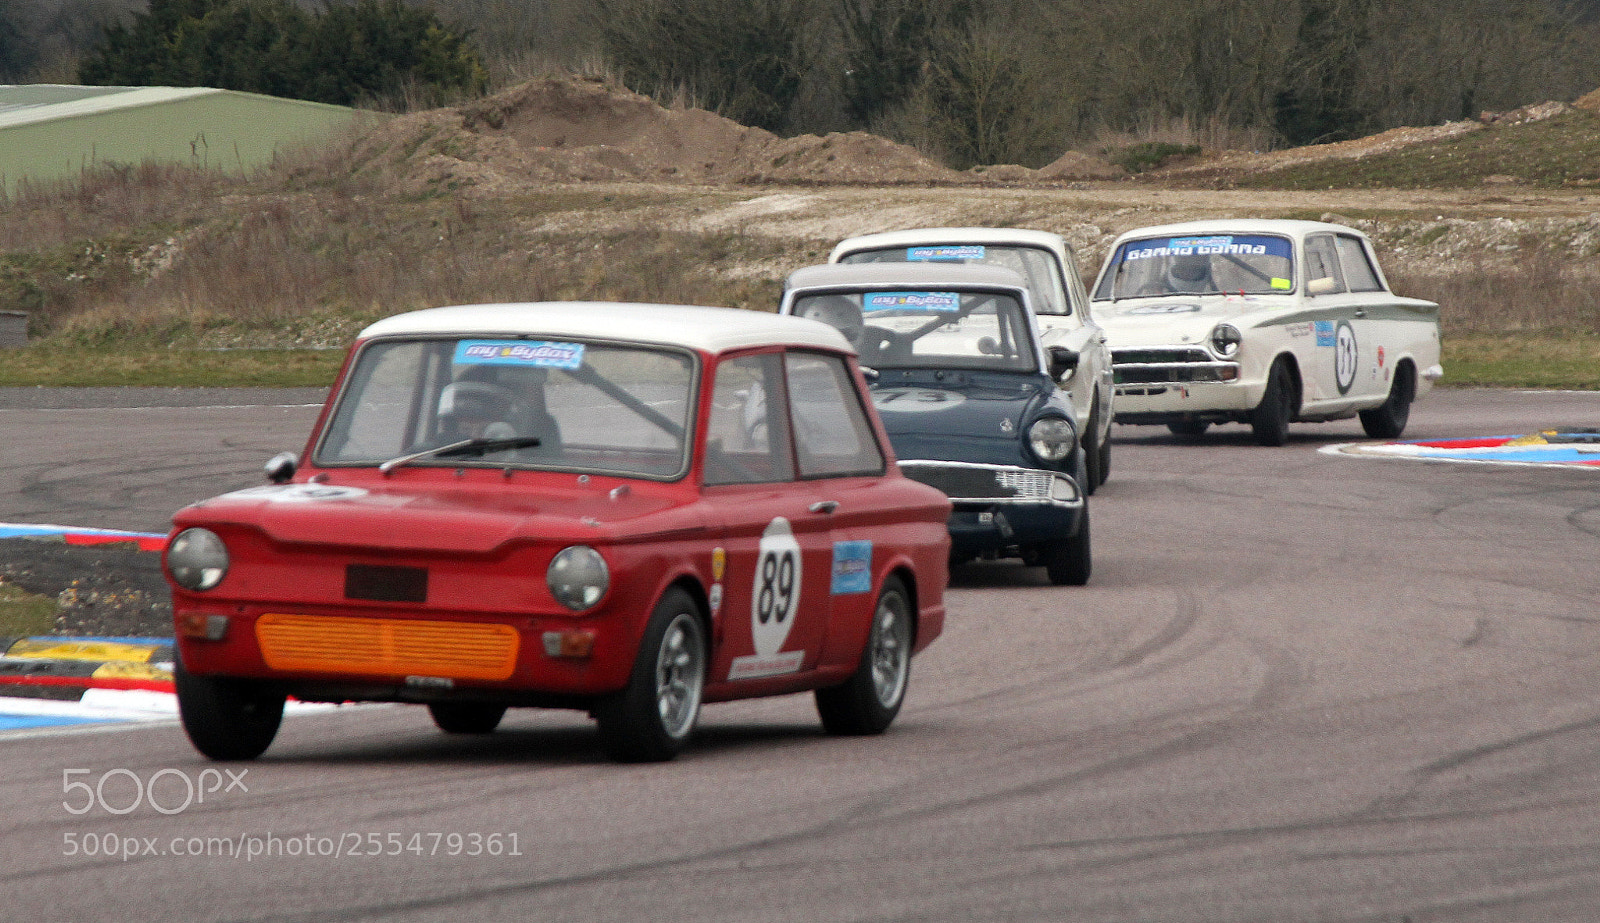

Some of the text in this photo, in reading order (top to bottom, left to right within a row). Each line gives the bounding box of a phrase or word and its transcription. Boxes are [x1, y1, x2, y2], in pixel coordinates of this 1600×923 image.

[871, 294, 954, 307] my ByBox
[464, 344, 576, 360] my ByBox
[873, 391, 948, 403] 73
[759, 552, 794, 623] 89
